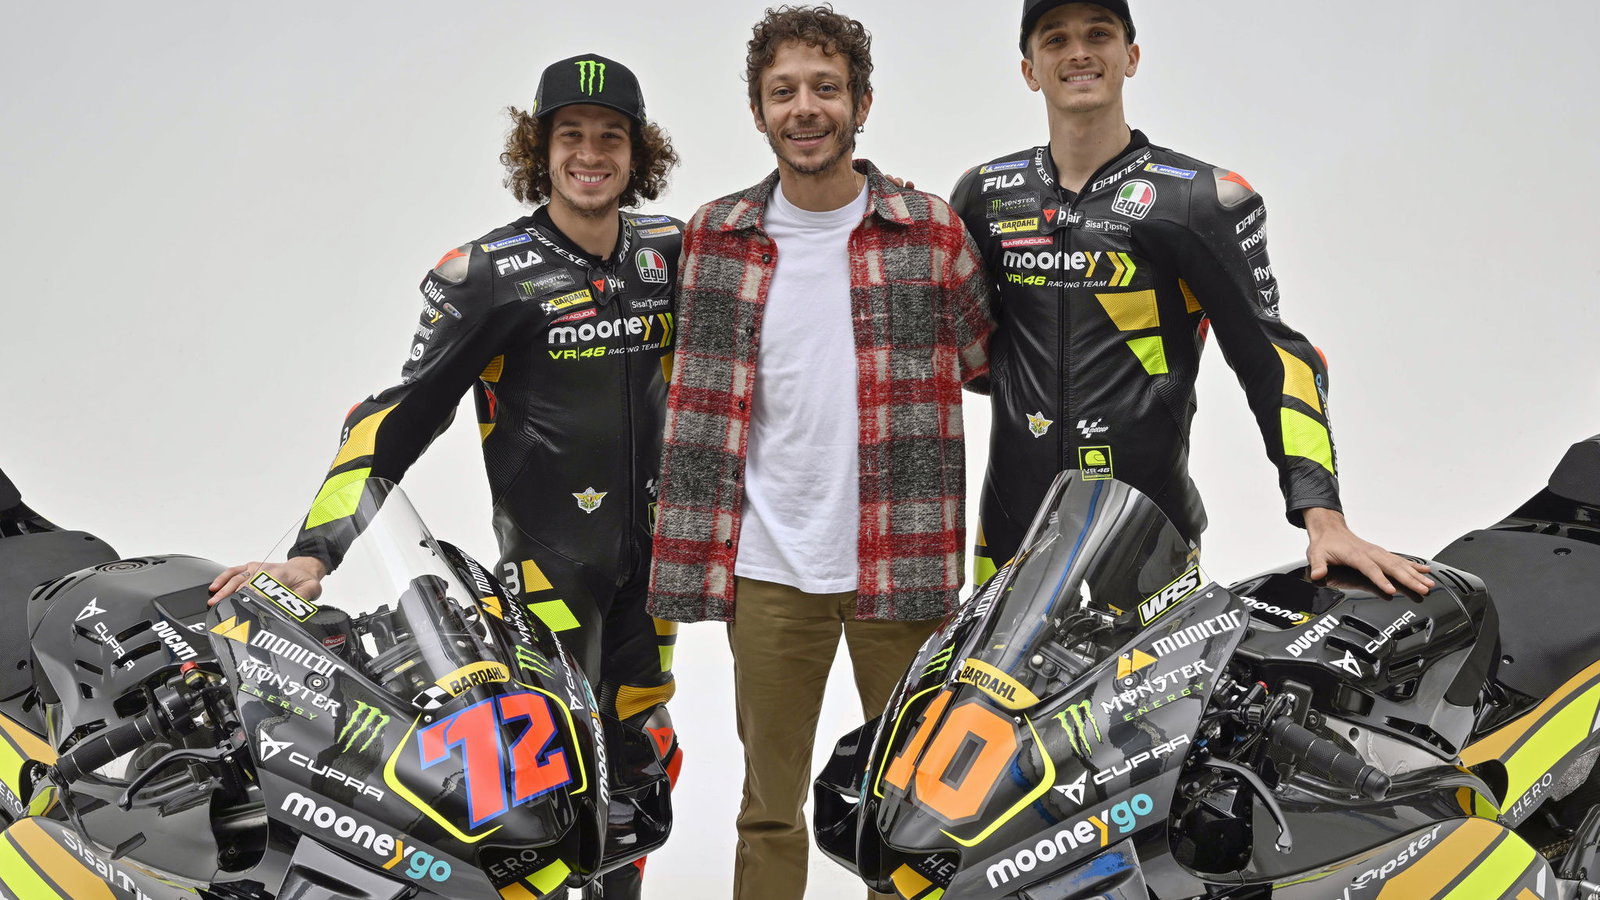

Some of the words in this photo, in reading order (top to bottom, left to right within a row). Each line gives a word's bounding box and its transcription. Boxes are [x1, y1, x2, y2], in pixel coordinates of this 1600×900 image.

[983, 172, 1025, 193] FILA
[1091, 150, 1153, 193] DAINESE
[1001, 219, 1036, 231] BARDAHL
[1002, 238, 1052, 248] BARRACUDA
[496, 250, 543, 276] FILA
[525, 227, 588, 267] DAINESE
[1003, 250, 1102, 278] mooney
[553, 291, 590, 306] BARDAHL
[1047, 280, 1080, 289] RACING
[1082, 280, 1108, 288] TEAM
[548, 315, 654, 344] mooney
[607, 346, 640, 356] RACING
[641, 342, 660, 351] TEAM
[253, 573, 314, 617] WRS
[1141, 569, 1198, 622] WRS
[1240, 595, 1311, 626] mooney
[94, 621, 136, 672] CUPRA
[151, 620, 199, 662] DUCATI
[1285, 614, 1340, 658] DUCATI
[1364, 610, 1417, 654] CUPRA
[236, 655, 342, 718] MONSTER
[450, 664, 505, 696] BARDAHL
[961, 665, 1017, 704] BARDAHL
[1100, 658, 1215, 715] MONSTER
[1123, 681, 1205, 721] ENERGY
[239, 683, 319, 721] ENERGY
[288, 751, 385, 802] CUPRA
[417, 689, 573, 831] 72
[881, 688, 1023, 827] 10
[1094, 733, 1192, 786] CUPRA
[1512, 772, 1552, 818] HERO
[280, 791, 452, 883] mooneygo
[986, 793, 1154, 890] mooneygo
